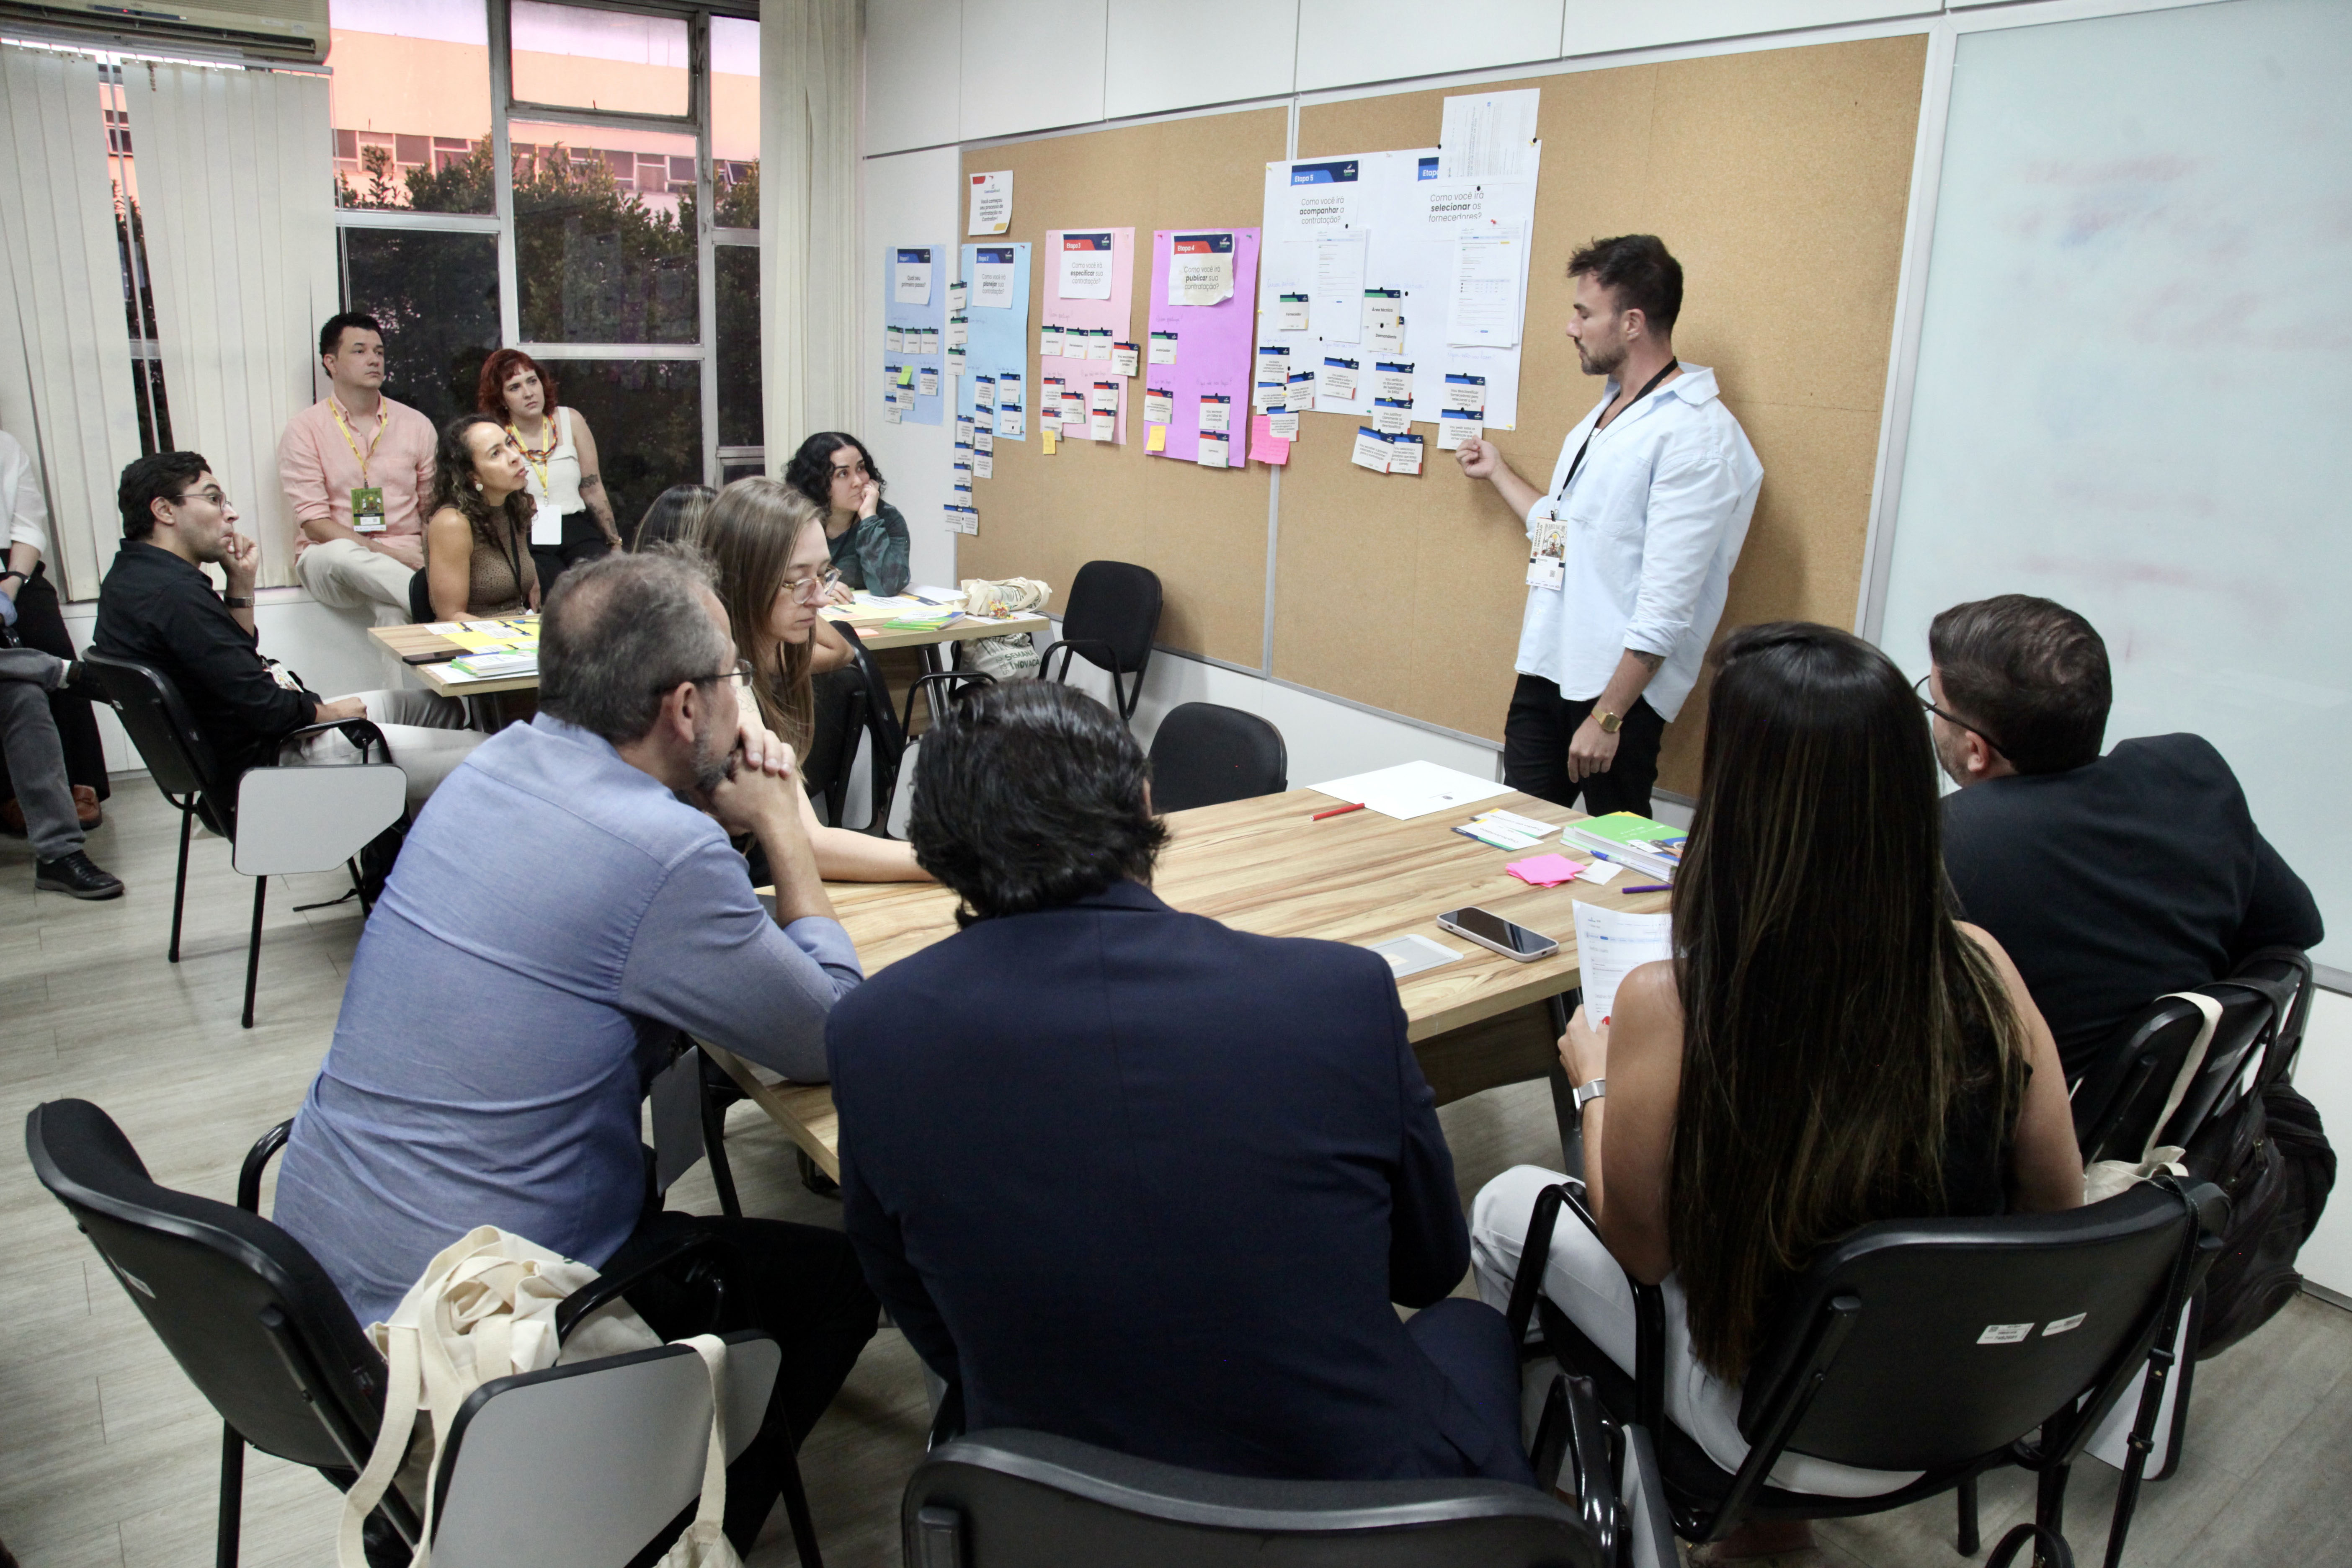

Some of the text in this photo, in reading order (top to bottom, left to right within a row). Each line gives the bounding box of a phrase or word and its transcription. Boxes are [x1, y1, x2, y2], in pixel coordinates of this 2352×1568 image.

[1320, 196, 1335, 204] você
[1454, 191, 1472, 200] você
[1474, 191, 1484, 199] irá
[1300, 206, 1338, 217] acompanhar
[1431, 203, 1471, 212] selecionar
[1301, 216, 1341, 225] contratação?
[1429, 212, 1482, 222] fornecedores?
[1186, 274, 1207, 283] publicar
[1184, 283, 1219, 291] contratação?
[1005, 650, 1035, 661] SEMANA
[995, 657, 1010, 676] 2025
[1009, 656, 1042, 670] INOVAÇÃ
